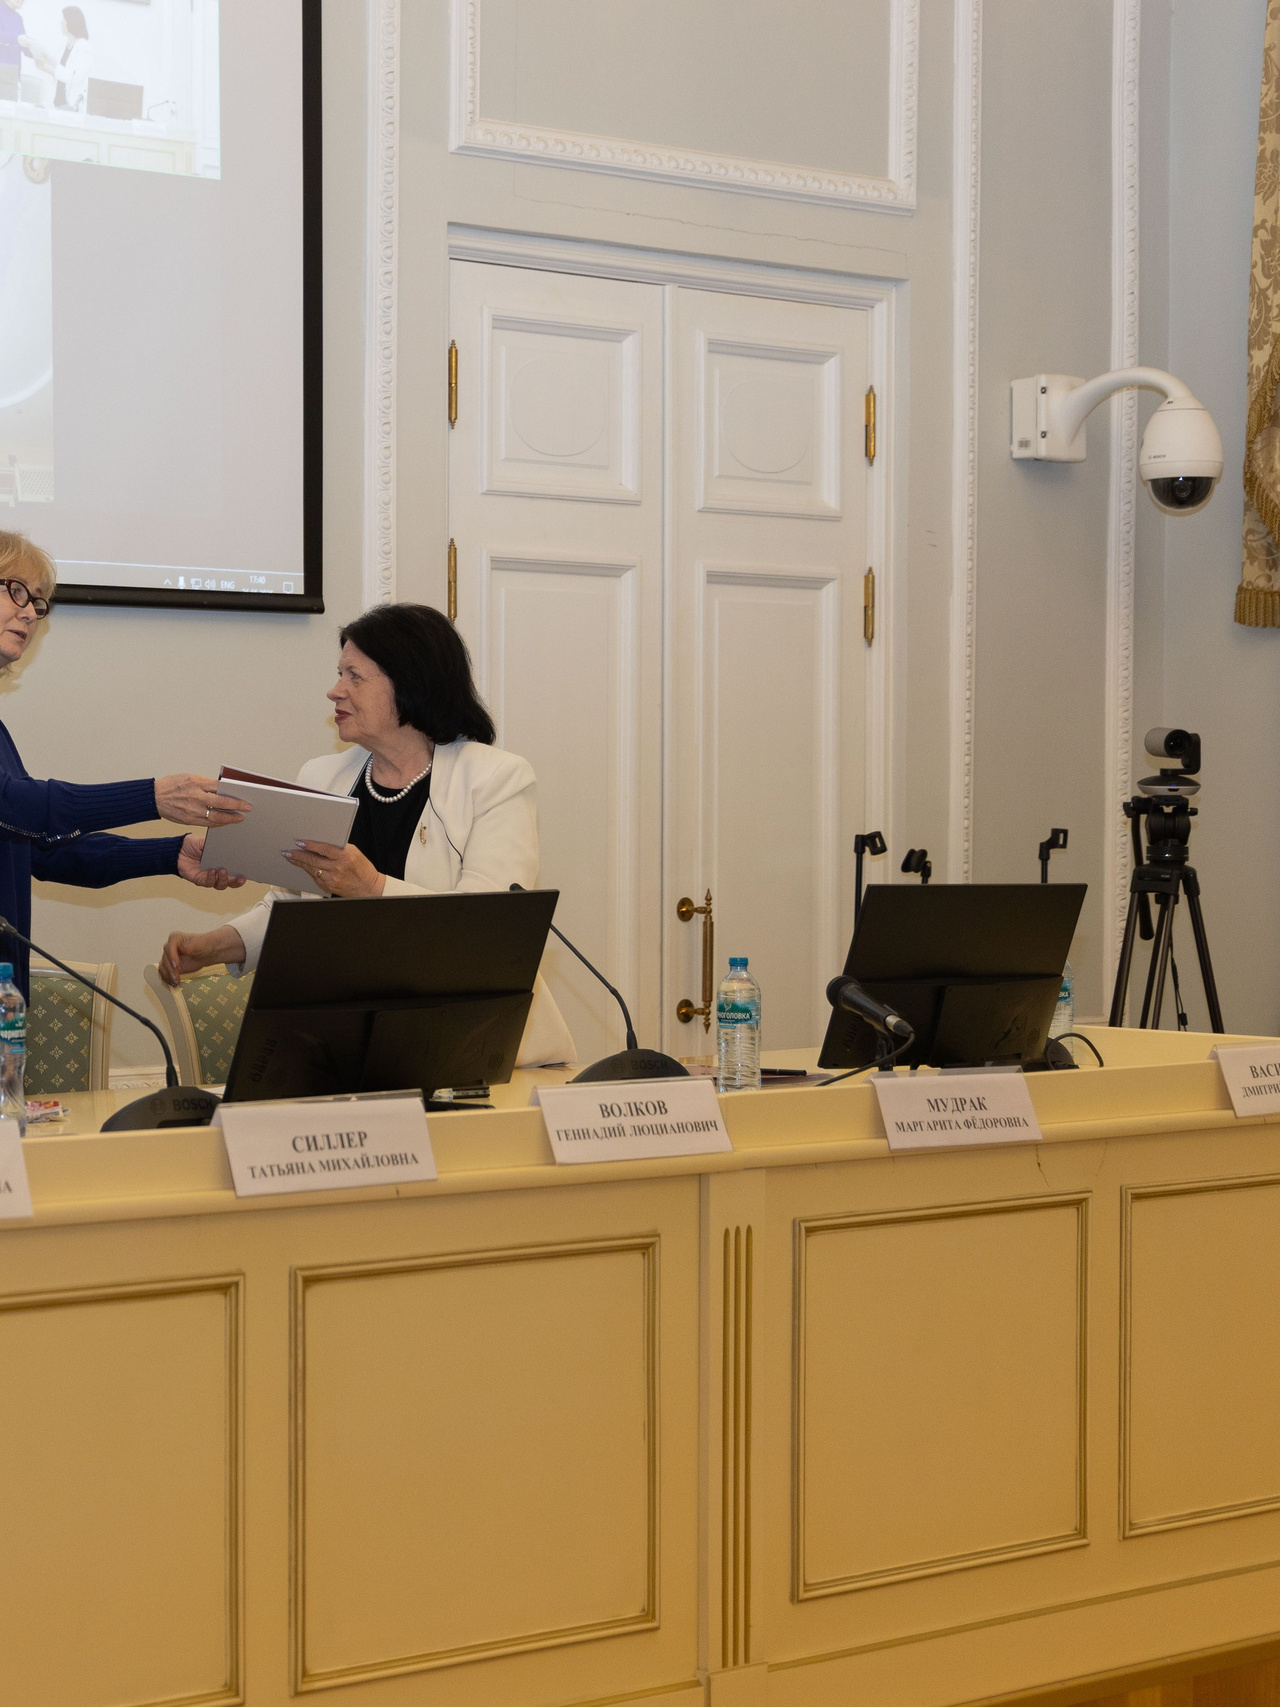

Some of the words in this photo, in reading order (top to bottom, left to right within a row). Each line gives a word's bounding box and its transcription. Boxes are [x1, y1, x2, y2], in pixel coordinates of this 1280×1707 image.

[220, 580, 235, 590] ENG
[249, 576, 266, 585] 17:40
[630, 1059, 669, 1070] BOSCH
[172, 1098, 214, 1111] BOSCH
[598, 1100, 669, 1119] ВОЛКОВ
[926, 1096, 988, 1114] МУДРАК
[556, 1123, 627, 1141] ГЕННАДИЙ
[629, 1120, 719, 1138] ЛЮЦИАНОВИЧ
[895, 1119, 962, 1133] МАРГАРИТА
[963, 1116, 1030, 1131] ФЁДОРОВНА
[291, 1130, 368, 1153] СИЛЛЕР
[247, 1161, 316, 1180] ТАТЬЯНА
[319, 1152, 419, 1174] МИХАЙЛОВНА
